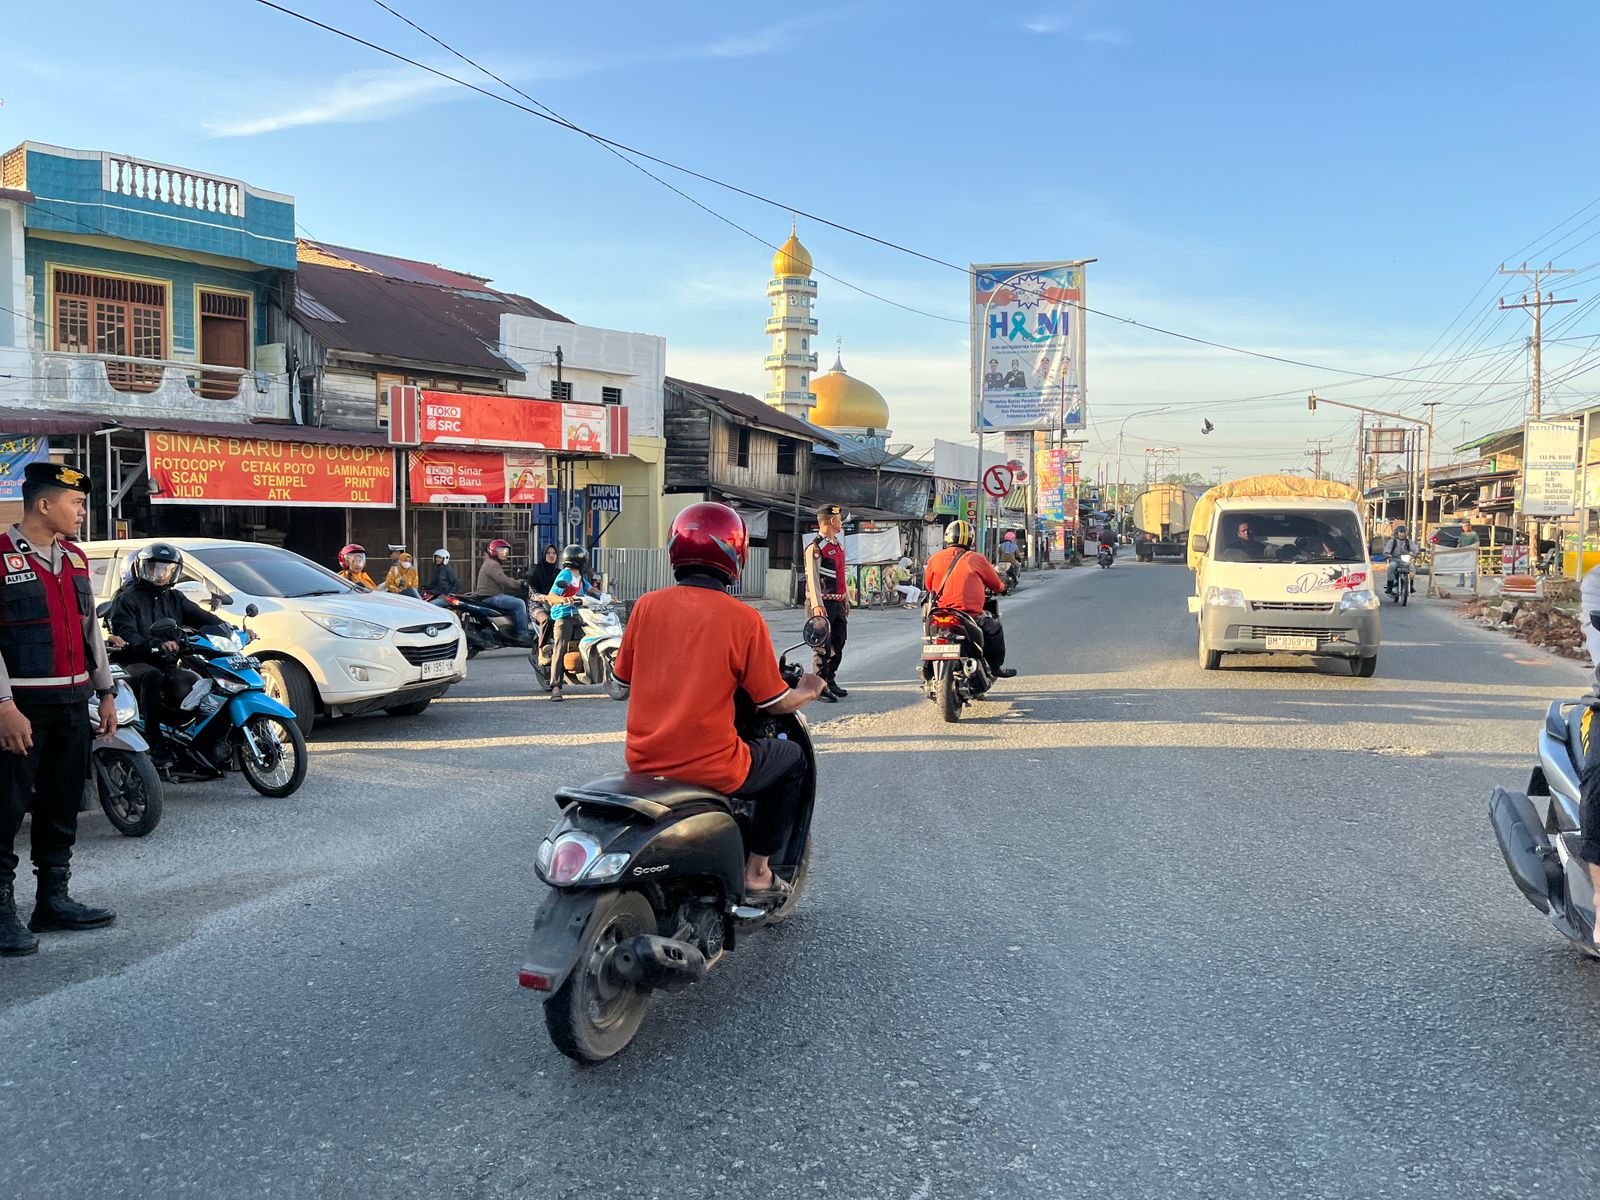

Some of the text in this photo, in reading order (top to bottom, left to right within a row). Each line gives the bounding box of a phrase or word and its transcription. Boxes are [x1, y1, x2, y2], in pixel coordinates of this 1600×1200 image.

[429, 406, 458, 417] TOKO
[438, 420, 461, 432] SRC
[156, 434, 386, 462] SINAR BARU FOTOCOPY
[154, 457, 226, 472] FOTOCOPY
[241, 460, 316, 475] CETAK POTO
[326, 464, 390, 477] LAMINATING
[430, 466, 451, 475] TOKO
[457, 465, 483, 476] Sinar
[171, 471, 207, 484] SCAN
[253, 474, 307, 488] STEMPEL
[344, 477, 376, 489] PRINT
[433, 476, 455, 486] SRC
[458, 477, 482, 487] Baru
[173, 485, 204, 497] JILID
[267, 488, 291, 500] ATK
[351, 490, 371, 502] DLL
[590, 499, 619, 511] GADAI
